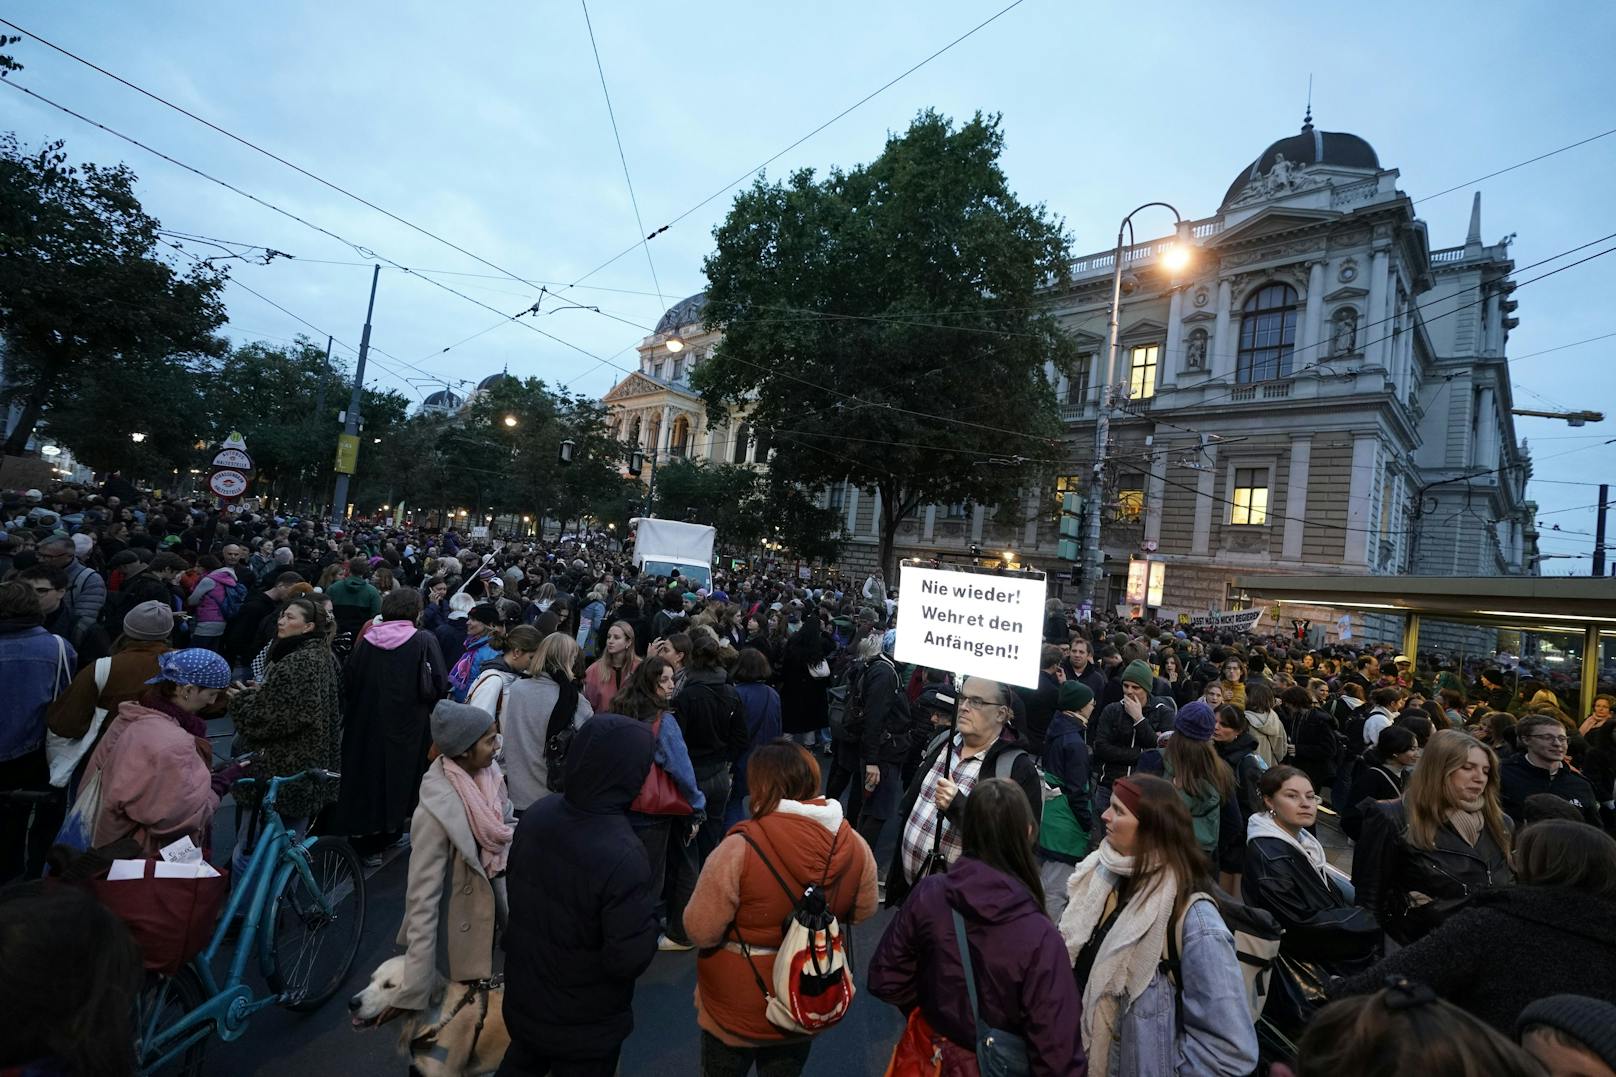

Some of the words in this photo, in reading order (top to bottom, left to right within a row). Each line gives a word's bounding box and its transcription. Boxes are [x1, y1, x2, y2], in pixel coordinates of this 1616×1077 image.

[922, 579, 948, 596] Nie
[953, 584, 1021, 604] wieder!
[922, 604, 985, 628] Wehret
[989, 615, 1023, 633] den
[924, 630, 1019, 660] Anfängen!!
